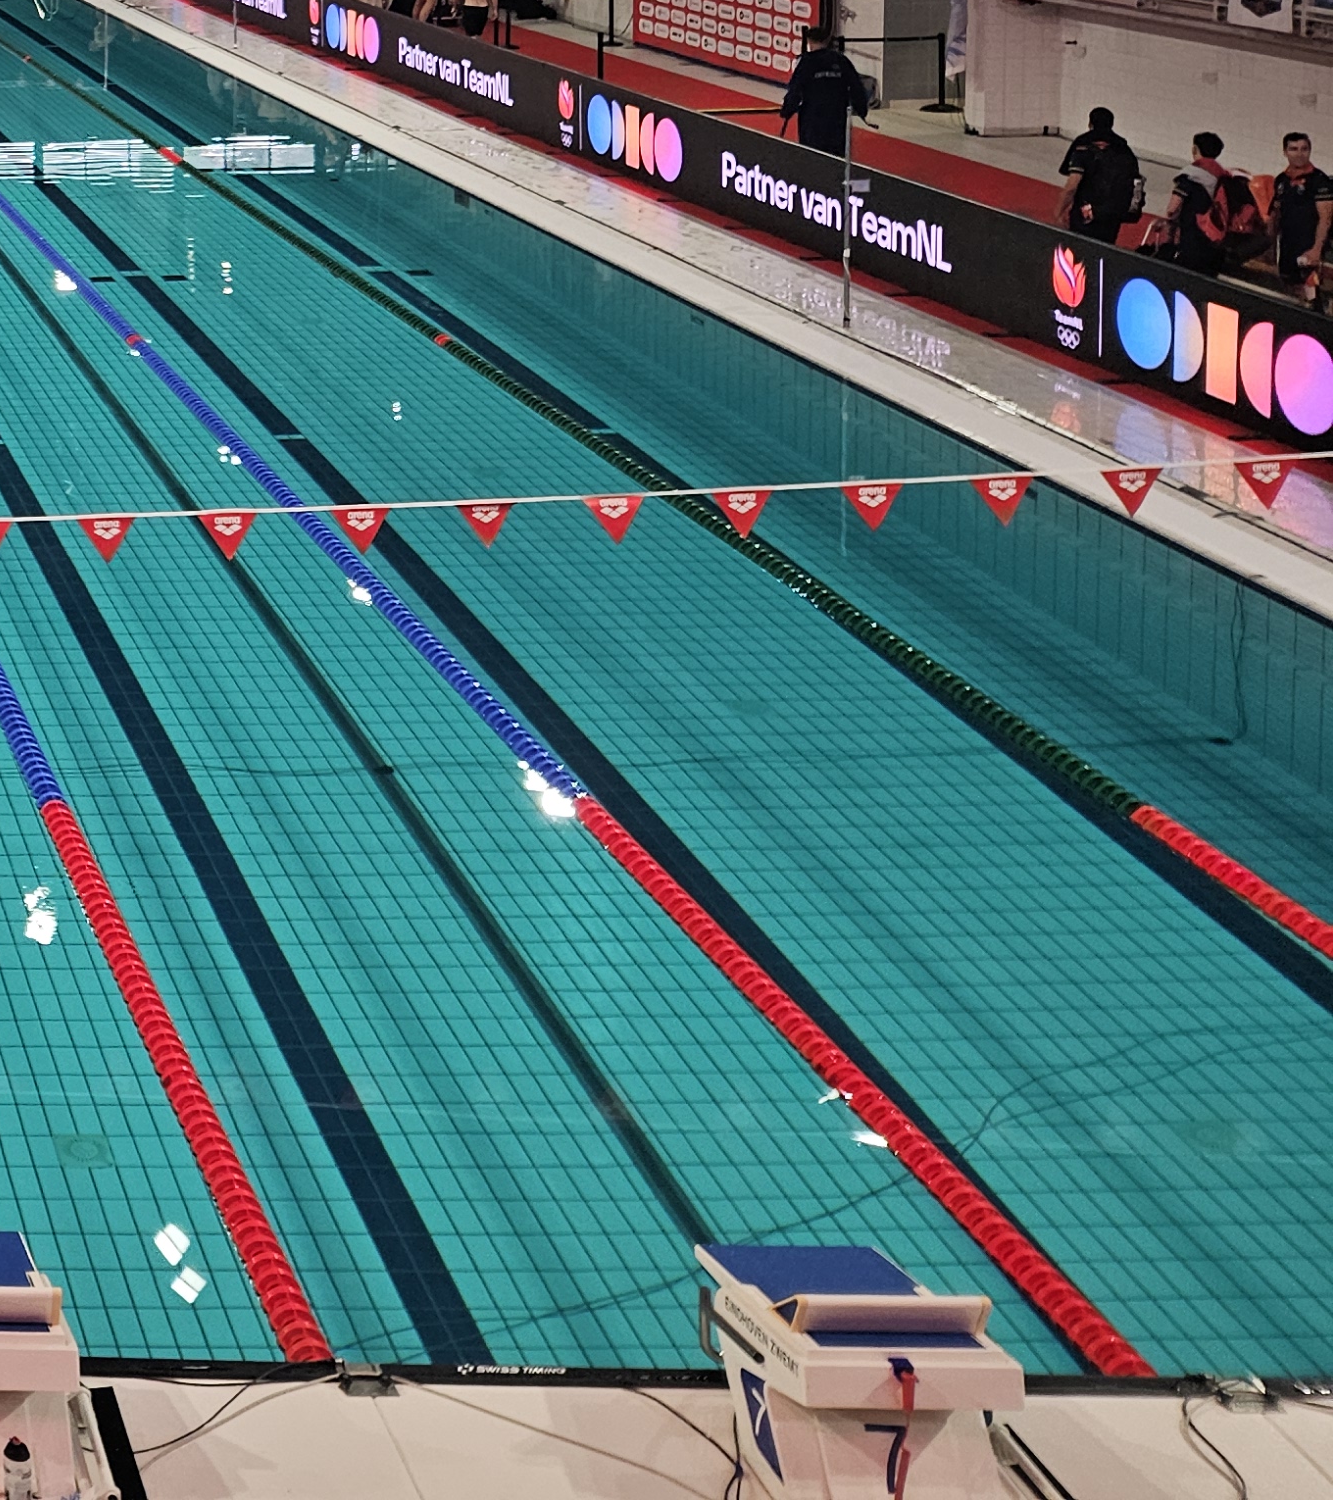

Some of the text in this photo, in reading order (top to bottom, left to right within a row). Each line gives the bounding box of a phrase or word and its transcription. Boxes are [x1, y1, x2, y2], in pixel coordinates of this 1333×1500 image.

[398, 36, 514, 107] Partner van TeamNL
[720, 151, 952, 274] Partner van TeamNL
[1253, 462, 1280, 473] arena
[1119, 471, 1146, 483] arena
[989, 480, 1017, 491] arena
[858, 487, 887, 497] arena
[728, 493, 757, 503] arena
[599, 499, 627, 509] arena
[214, 516, 241, 526] arena
[347, 511, 374, 521] arena
[94, 520, 120, 530] arena
[724, 1296, 800, 1379] EINDHOVEN ZWEMT
[476, 1365, 566, 1375] SWISS TIMING
[751, 1387, 767, 1437] 7
[864, 1423, 907, 1494] 7
